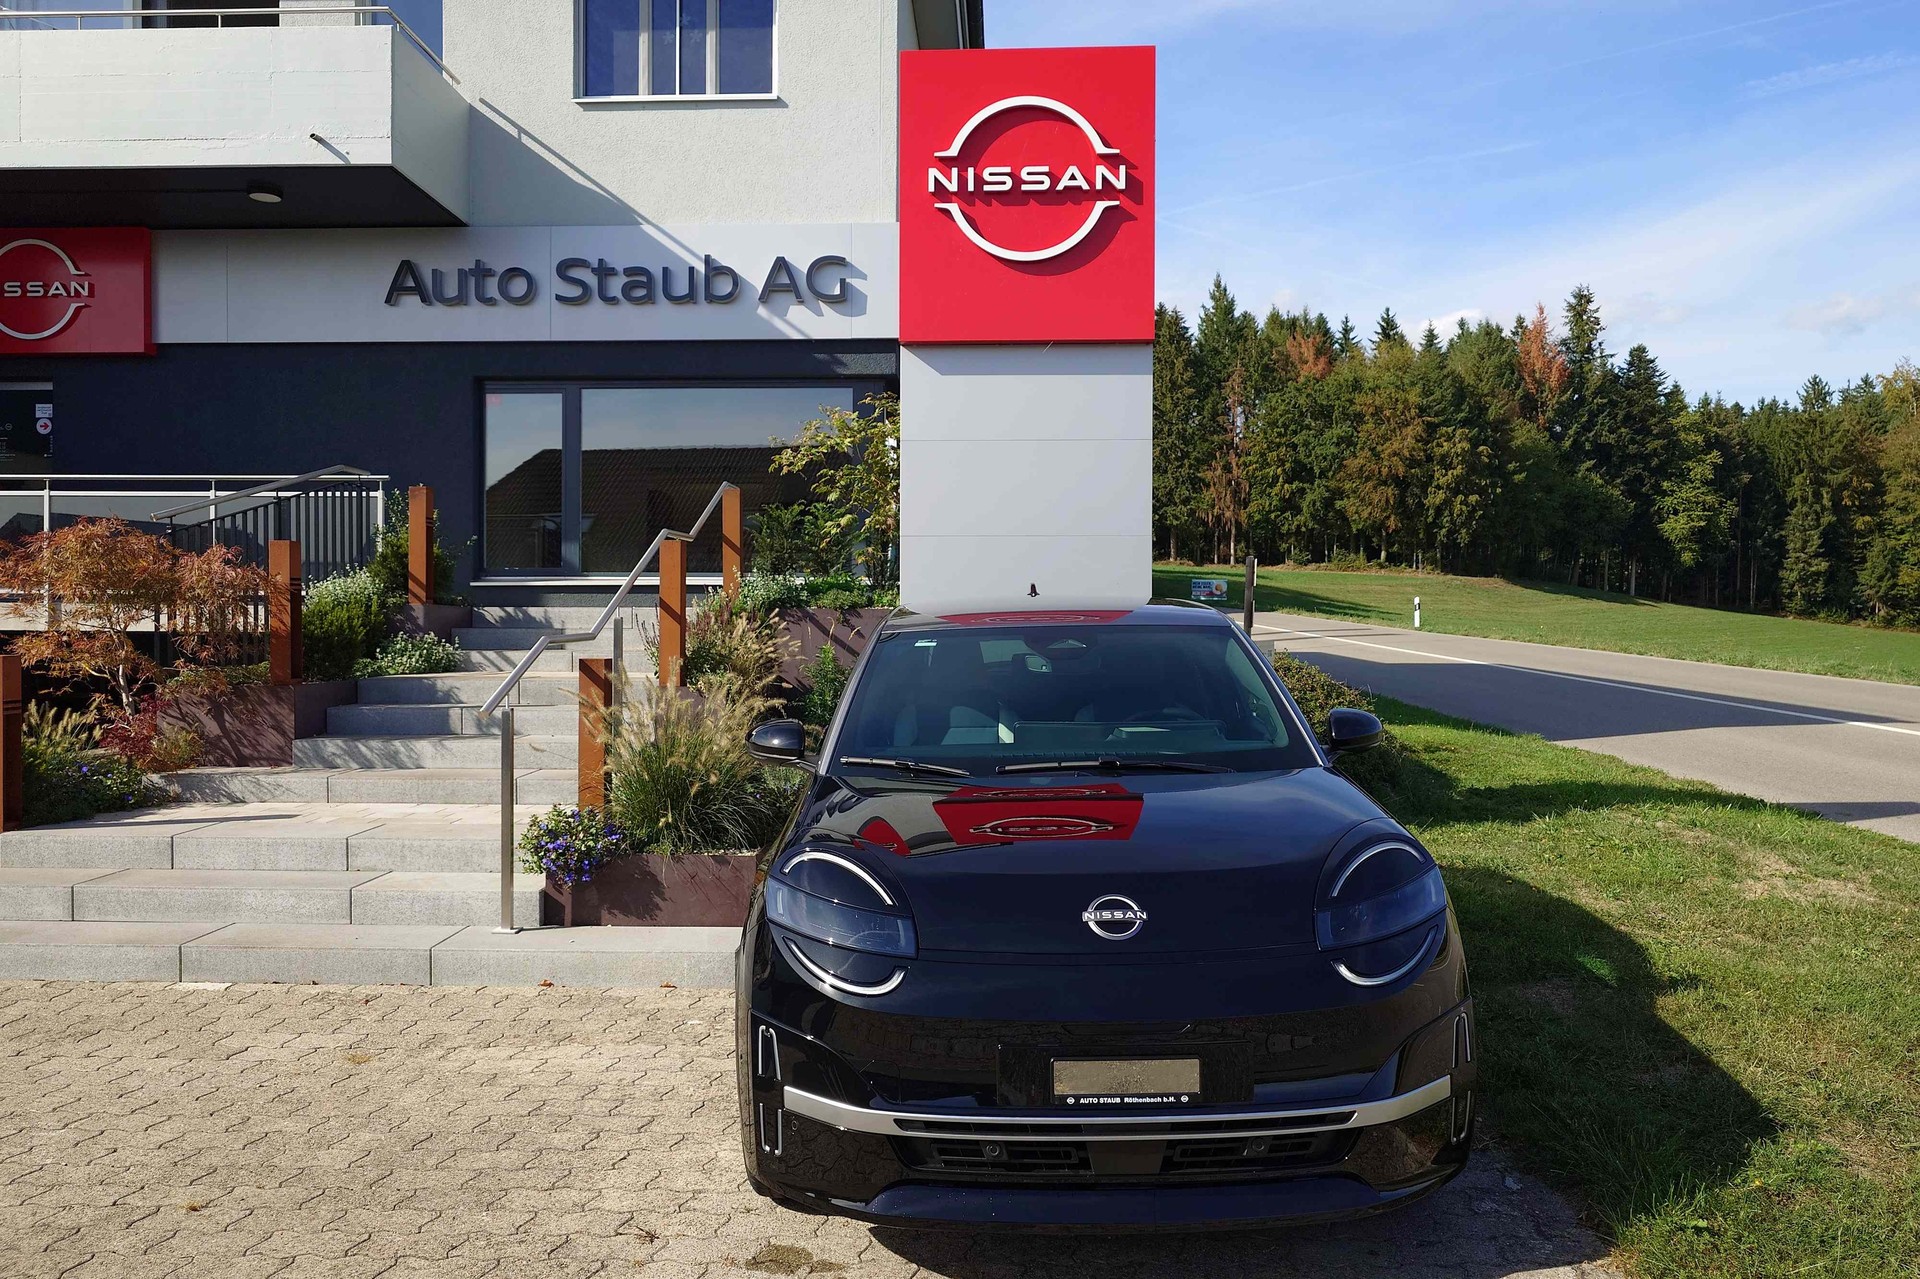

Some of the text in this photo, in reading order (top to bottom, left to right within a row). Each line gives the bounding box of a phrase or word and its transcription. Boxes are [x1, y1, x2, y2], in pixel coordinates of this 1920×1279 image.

[928, 164, 1126, 193] NISSAN
[384, 253, 848, 307] Auto Staub AG
[1084, 911, 1147, 920] NISSAN
